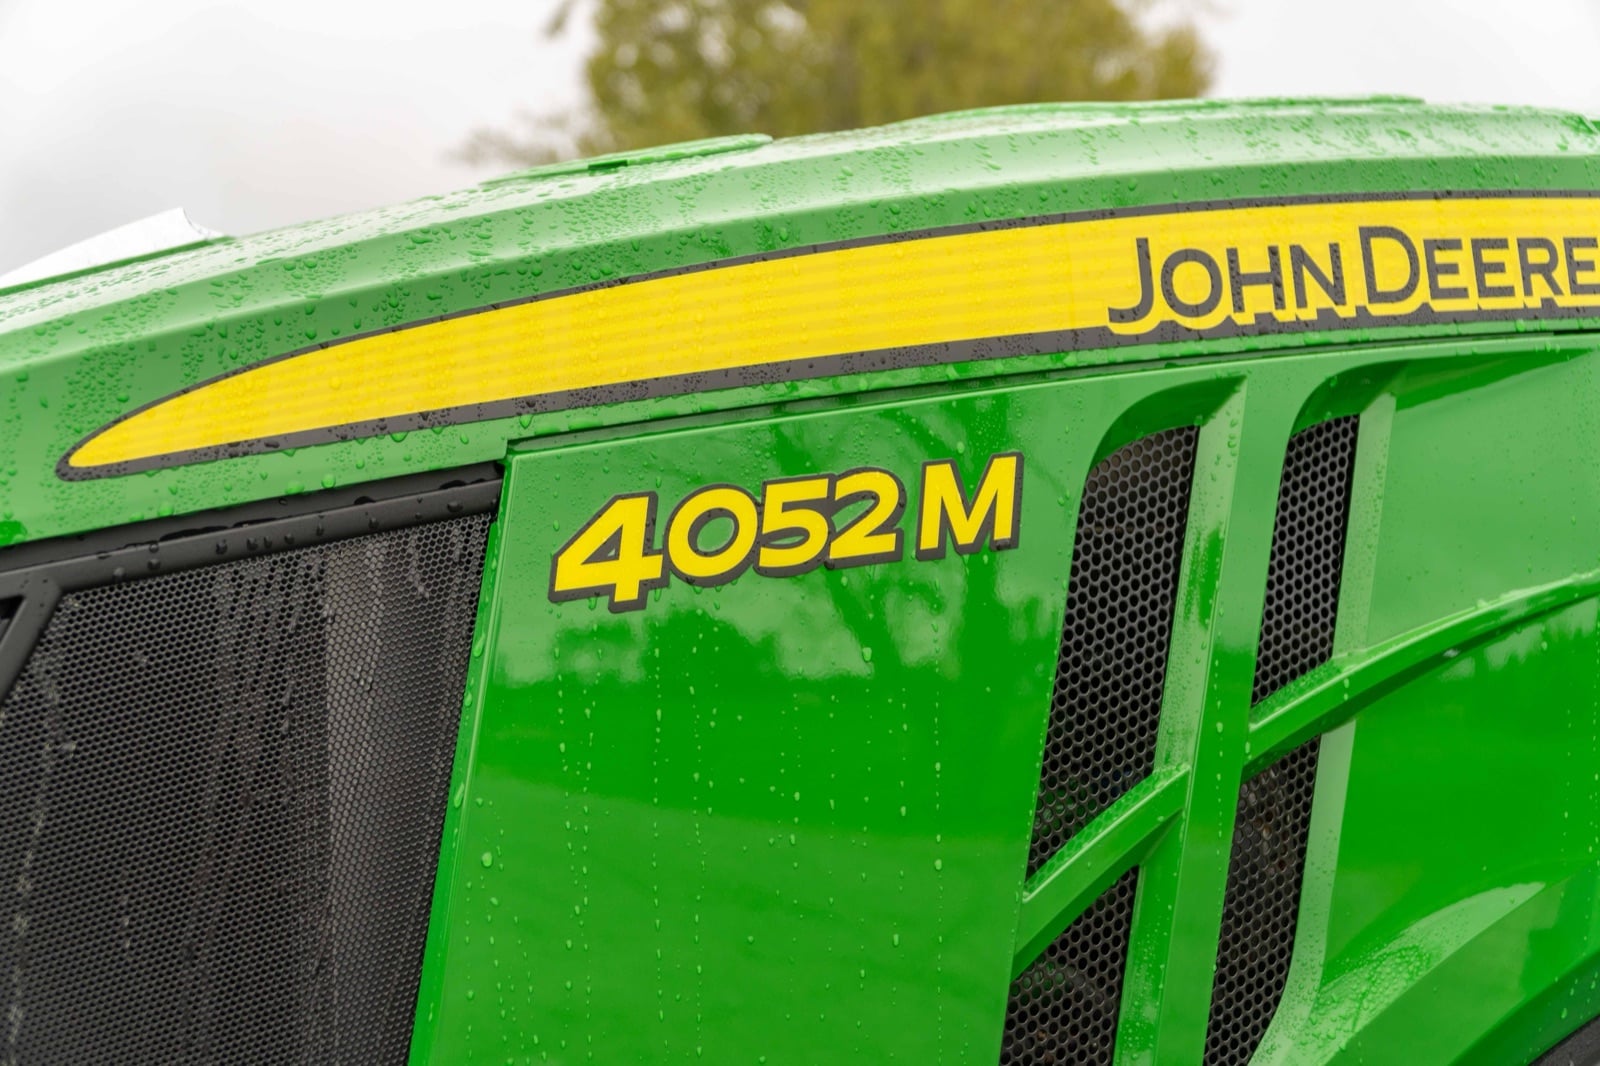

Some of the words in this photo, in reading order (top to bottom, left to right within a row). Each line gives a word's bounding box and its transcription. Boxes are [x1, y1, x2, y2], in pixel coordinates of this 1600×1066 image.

[1107, 237, 1346, 324] JOHN
[1358, 226, 1600, 305] DEERE
[551, 468, 903, 608] 4052
[917, 454, 1020, 556] M
